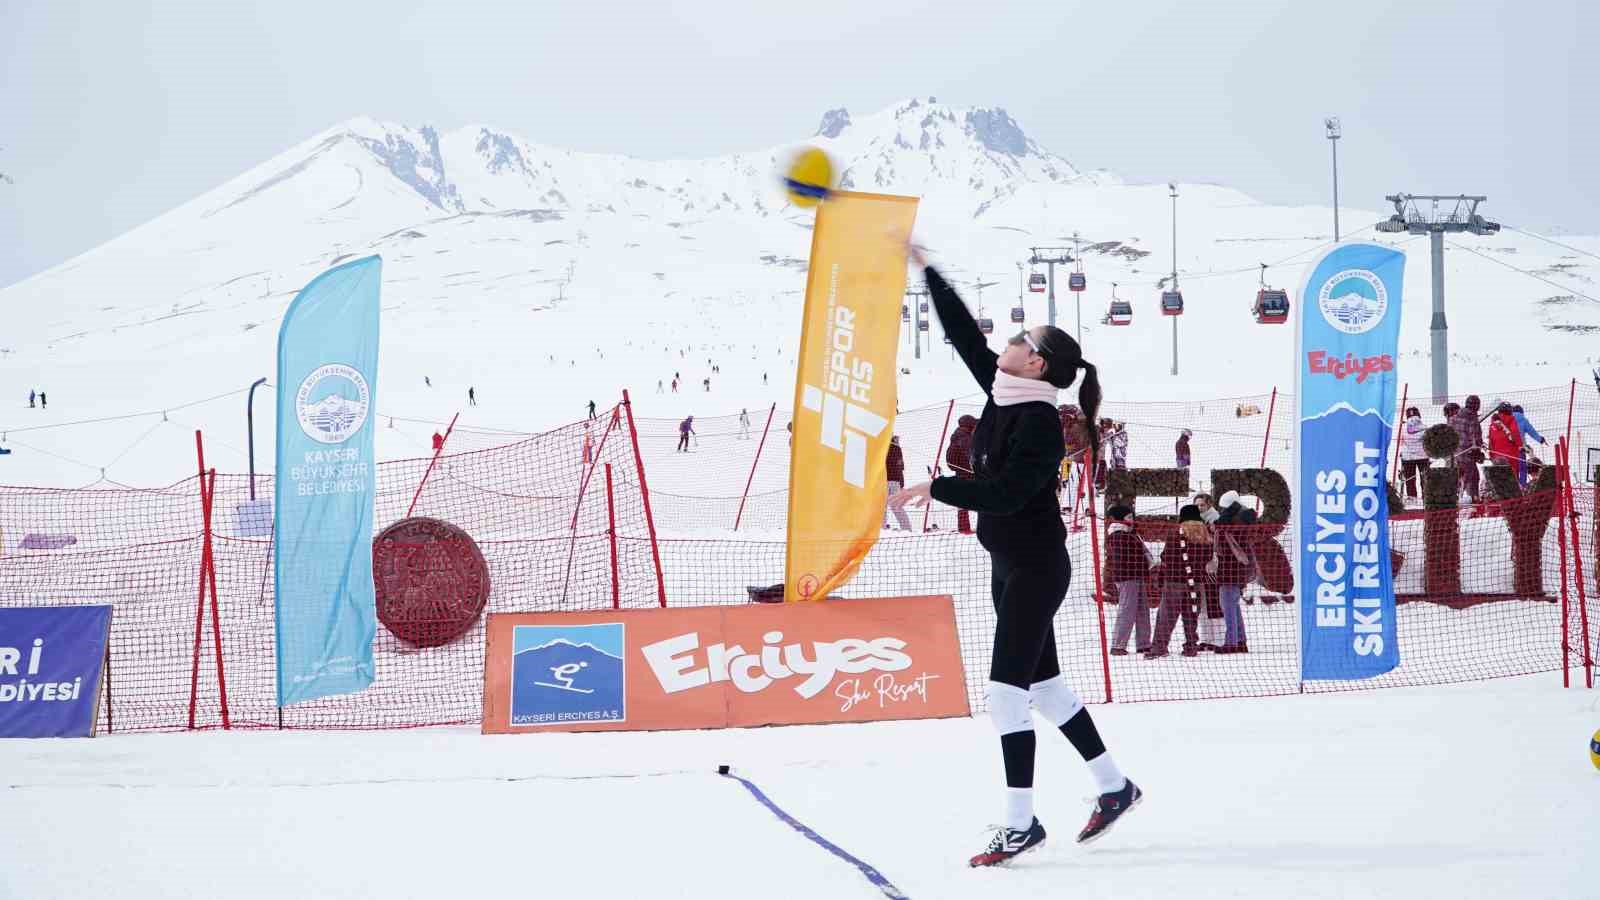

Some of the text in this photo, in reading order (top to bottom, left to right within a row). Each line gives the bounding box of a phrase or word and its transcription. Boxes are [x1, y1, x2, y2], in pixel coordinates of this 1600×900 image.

[829, 305, 856, 394] SPOR
[1307, 351, 1394, 384] Erciyes
[1307, 470, 1347, 627] ERCİYES
[1353, 441, 1384, 656] SKI RESORT
[641, 631, 912, 700] Erciyes
[874, 672, 940, 708] Resort
[513, 712, 555, 723] KAYSERİ
[558, 709, 600, 721] ERCİYES
